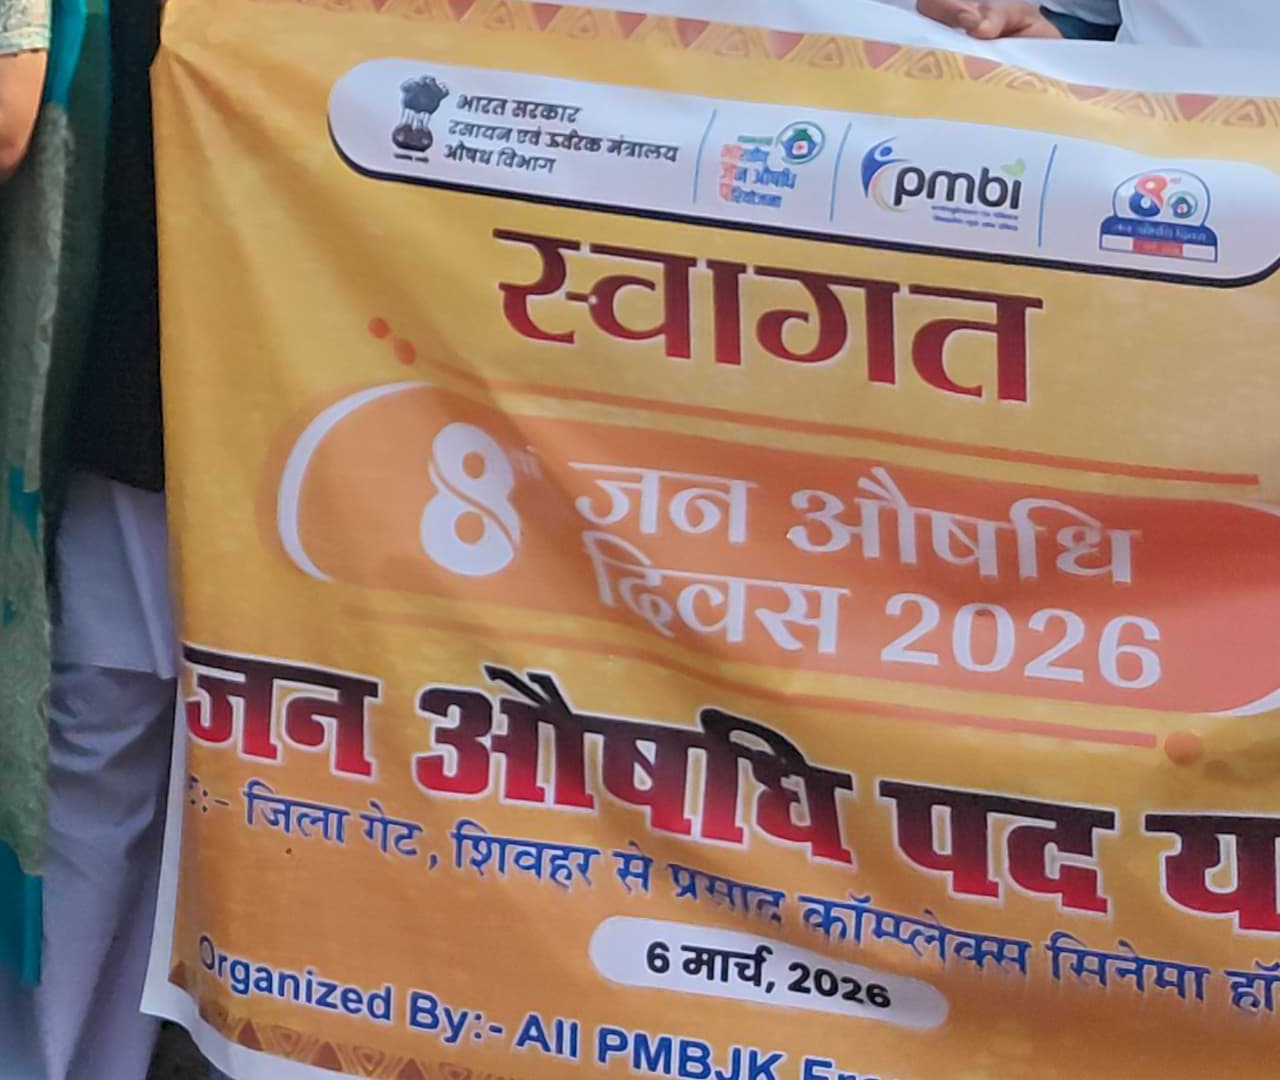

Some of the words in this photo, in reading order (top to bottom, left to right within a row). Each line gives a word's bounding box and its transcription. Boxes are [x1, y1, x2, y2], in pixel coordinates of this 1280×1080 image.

[456, 94, 508, 117] भारत
[511, 98, 582, 123] सरकार
[495, 150, 557, 175] विभाग
[516, 123, 542, 148] एवं
[606, 133, 679, 163] मंत्रालय
[893, 166, 1022, 210] pmbi
[491, 228, 1044, 403] स्वागत
[420, 422, 522, 577] 8
[568, 461, 760, 544] जन
[788, 467, 1144, 586] औषधि
[581, 531, 847, 653] दिवस
[879, 594, 1163, 690] 2026
[183, 646, 380, 778] जन
[414, 663, 854, 866] औषधि
[878, 779, 1116, 915] पद
[1144, 812, 1280, 933] य
[243, 779, 348, 842] जिला
[452, 819, 600, 891] शिवहर
[612, 841, 654, 894] से
[668, 862, 784, 923] प्रसाद
[799, 894, 1031, 974] कॉम्प्लेक्स
[1046, 932, 1210, 1001] सिनेमा
[199, 936, 392, 1021] Organized
[409, 991, 504, 1044] By:-
[517, 1014, 578, 1058] All
[597, 1027, 786, 1080] PMBJK
[646, 942, 670, 973] 6
[682, 944, 776, 993] मार्च,
[788, 962, 891, 1009] 2026
